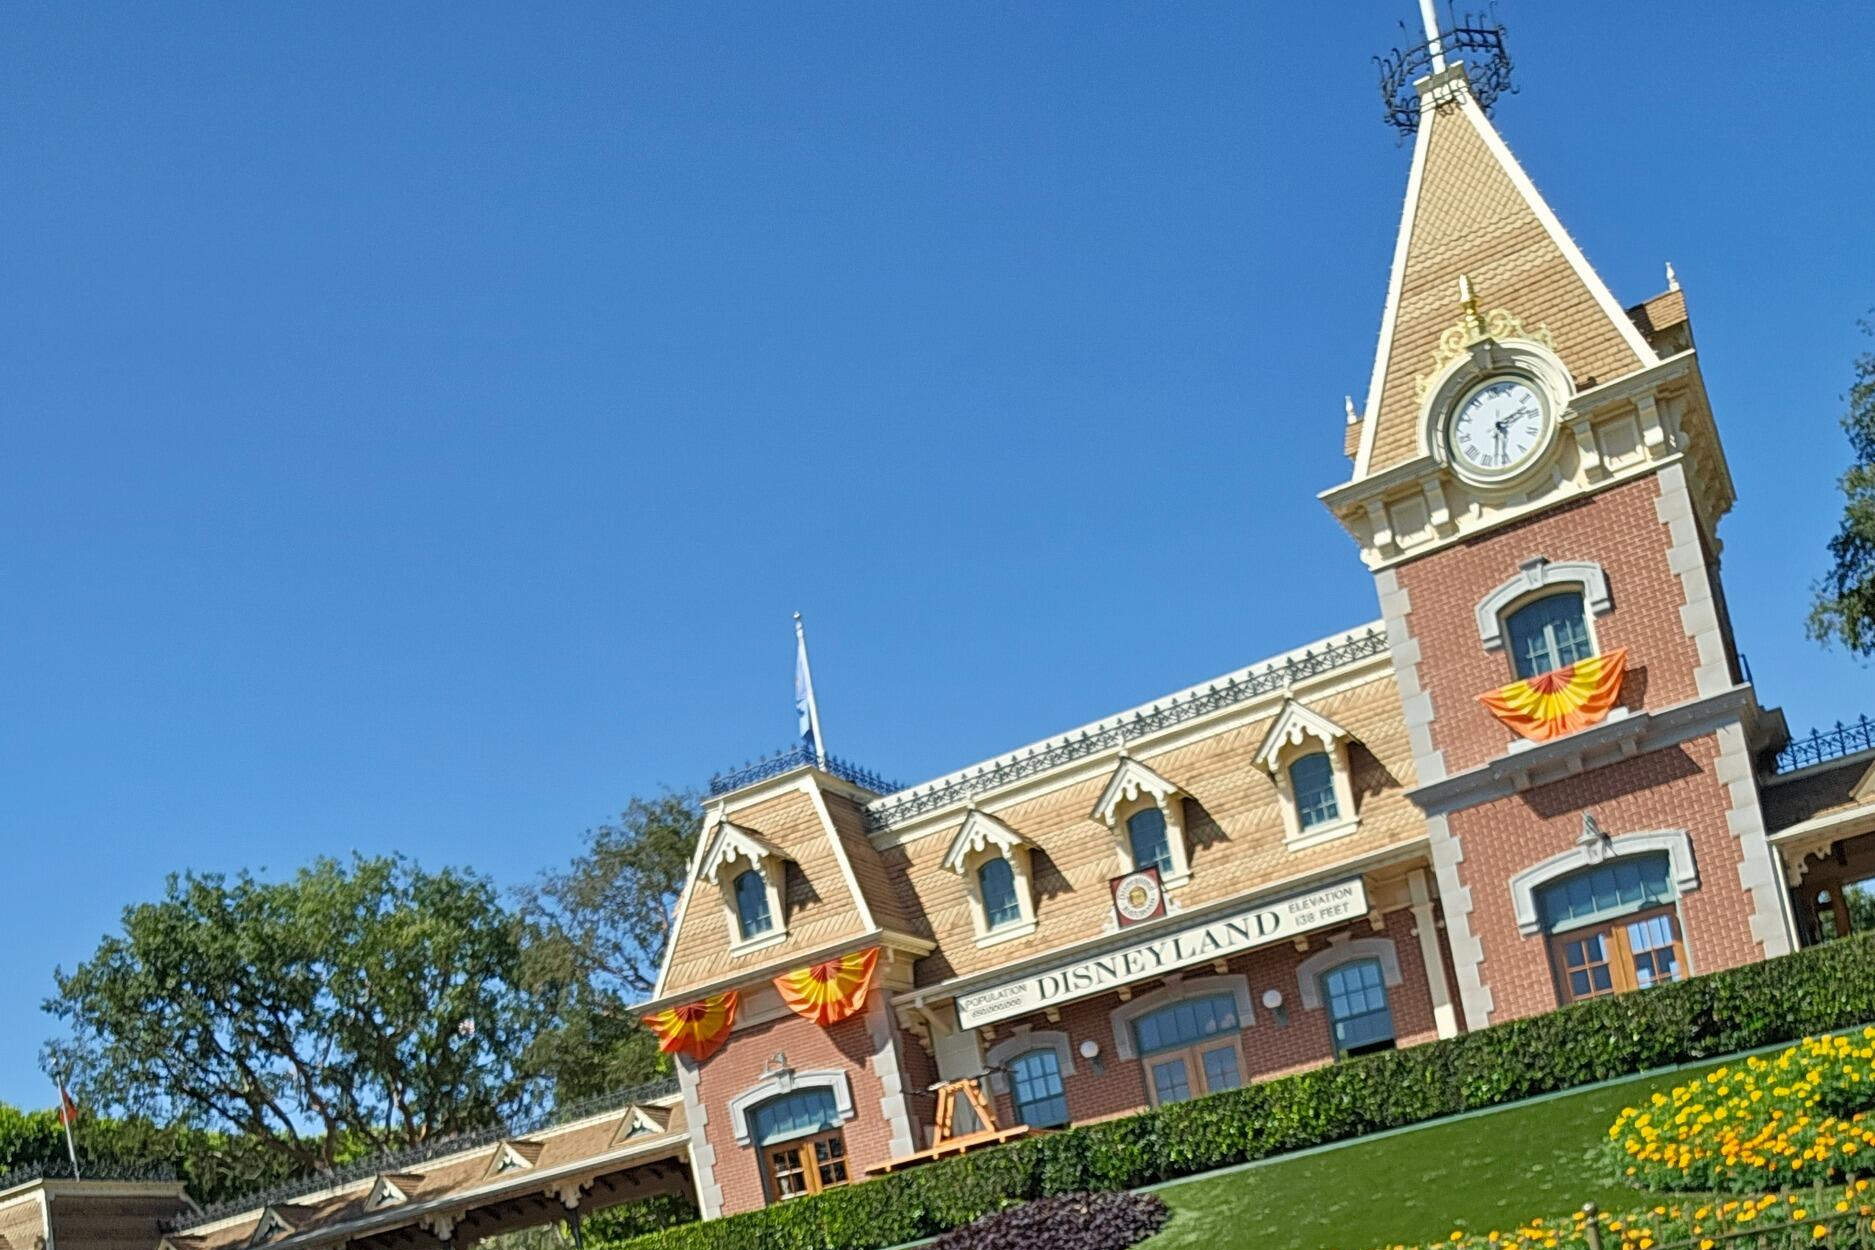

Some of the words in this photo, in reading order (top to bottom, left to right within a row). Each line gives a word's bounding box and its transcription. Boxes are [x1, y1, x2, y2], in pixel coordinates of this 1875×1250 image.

[1288, 887, 1353, 914] ELEVATION
[1320, 902, 1350, 920] FEET
[1036, 911, 1281, 1001] DISNEYLAND
[965, 983, 1028, 1009] POPULATION
